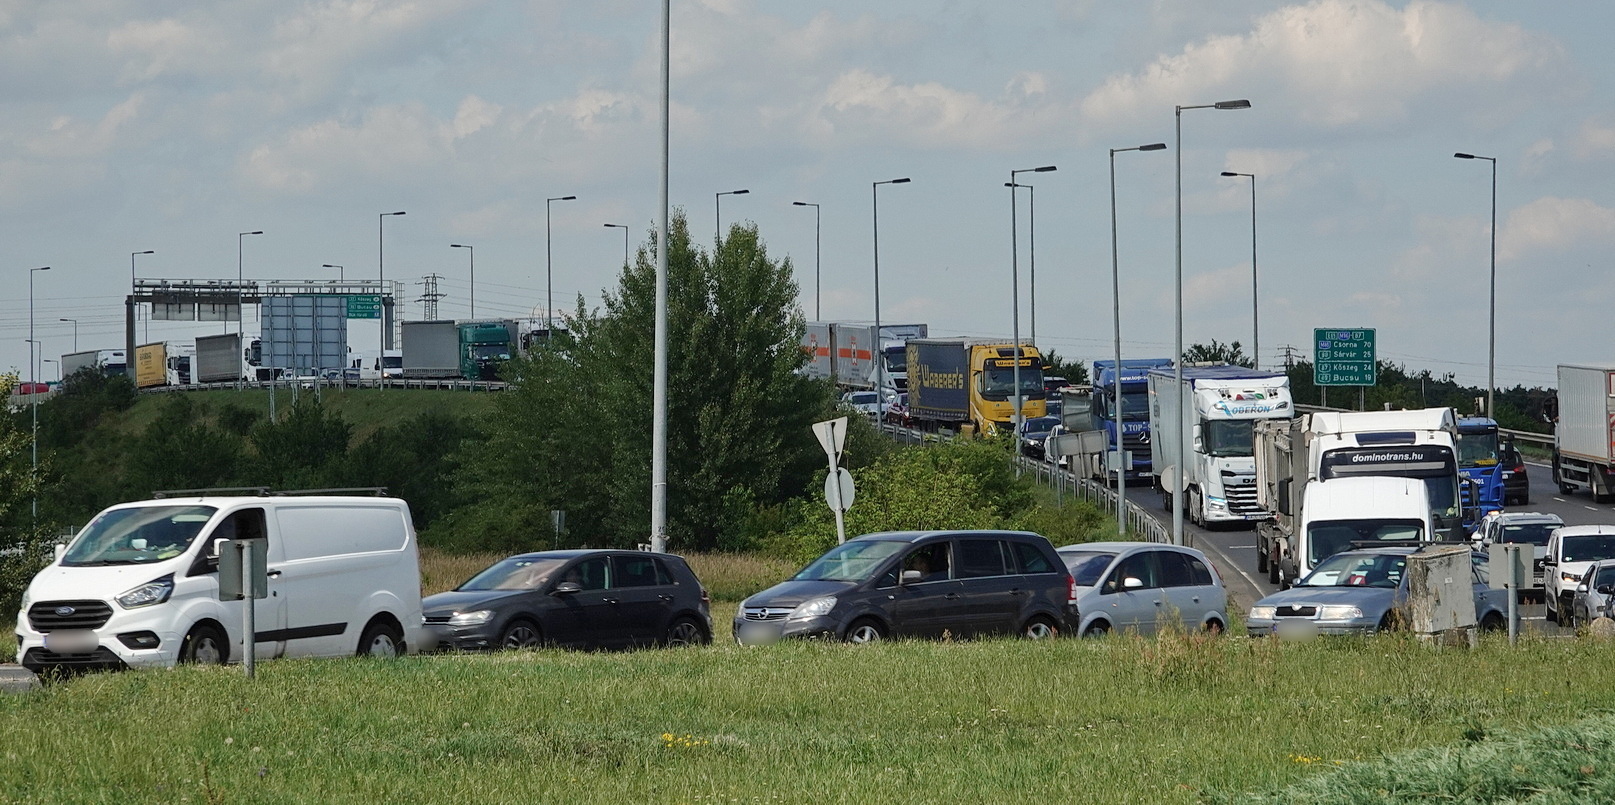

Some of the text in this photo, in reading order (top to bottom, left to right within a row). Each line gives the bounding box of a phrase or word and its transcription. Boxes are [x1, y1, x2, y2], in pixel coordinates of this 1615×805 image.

[1333, 350, 1357, 358] Sárvár
[1333, 363, 1359, 372] Kőszeg
[1231, 405, 1271, 415] OBERON
[1352, 451, 1424, 463] dominotrans.hu
